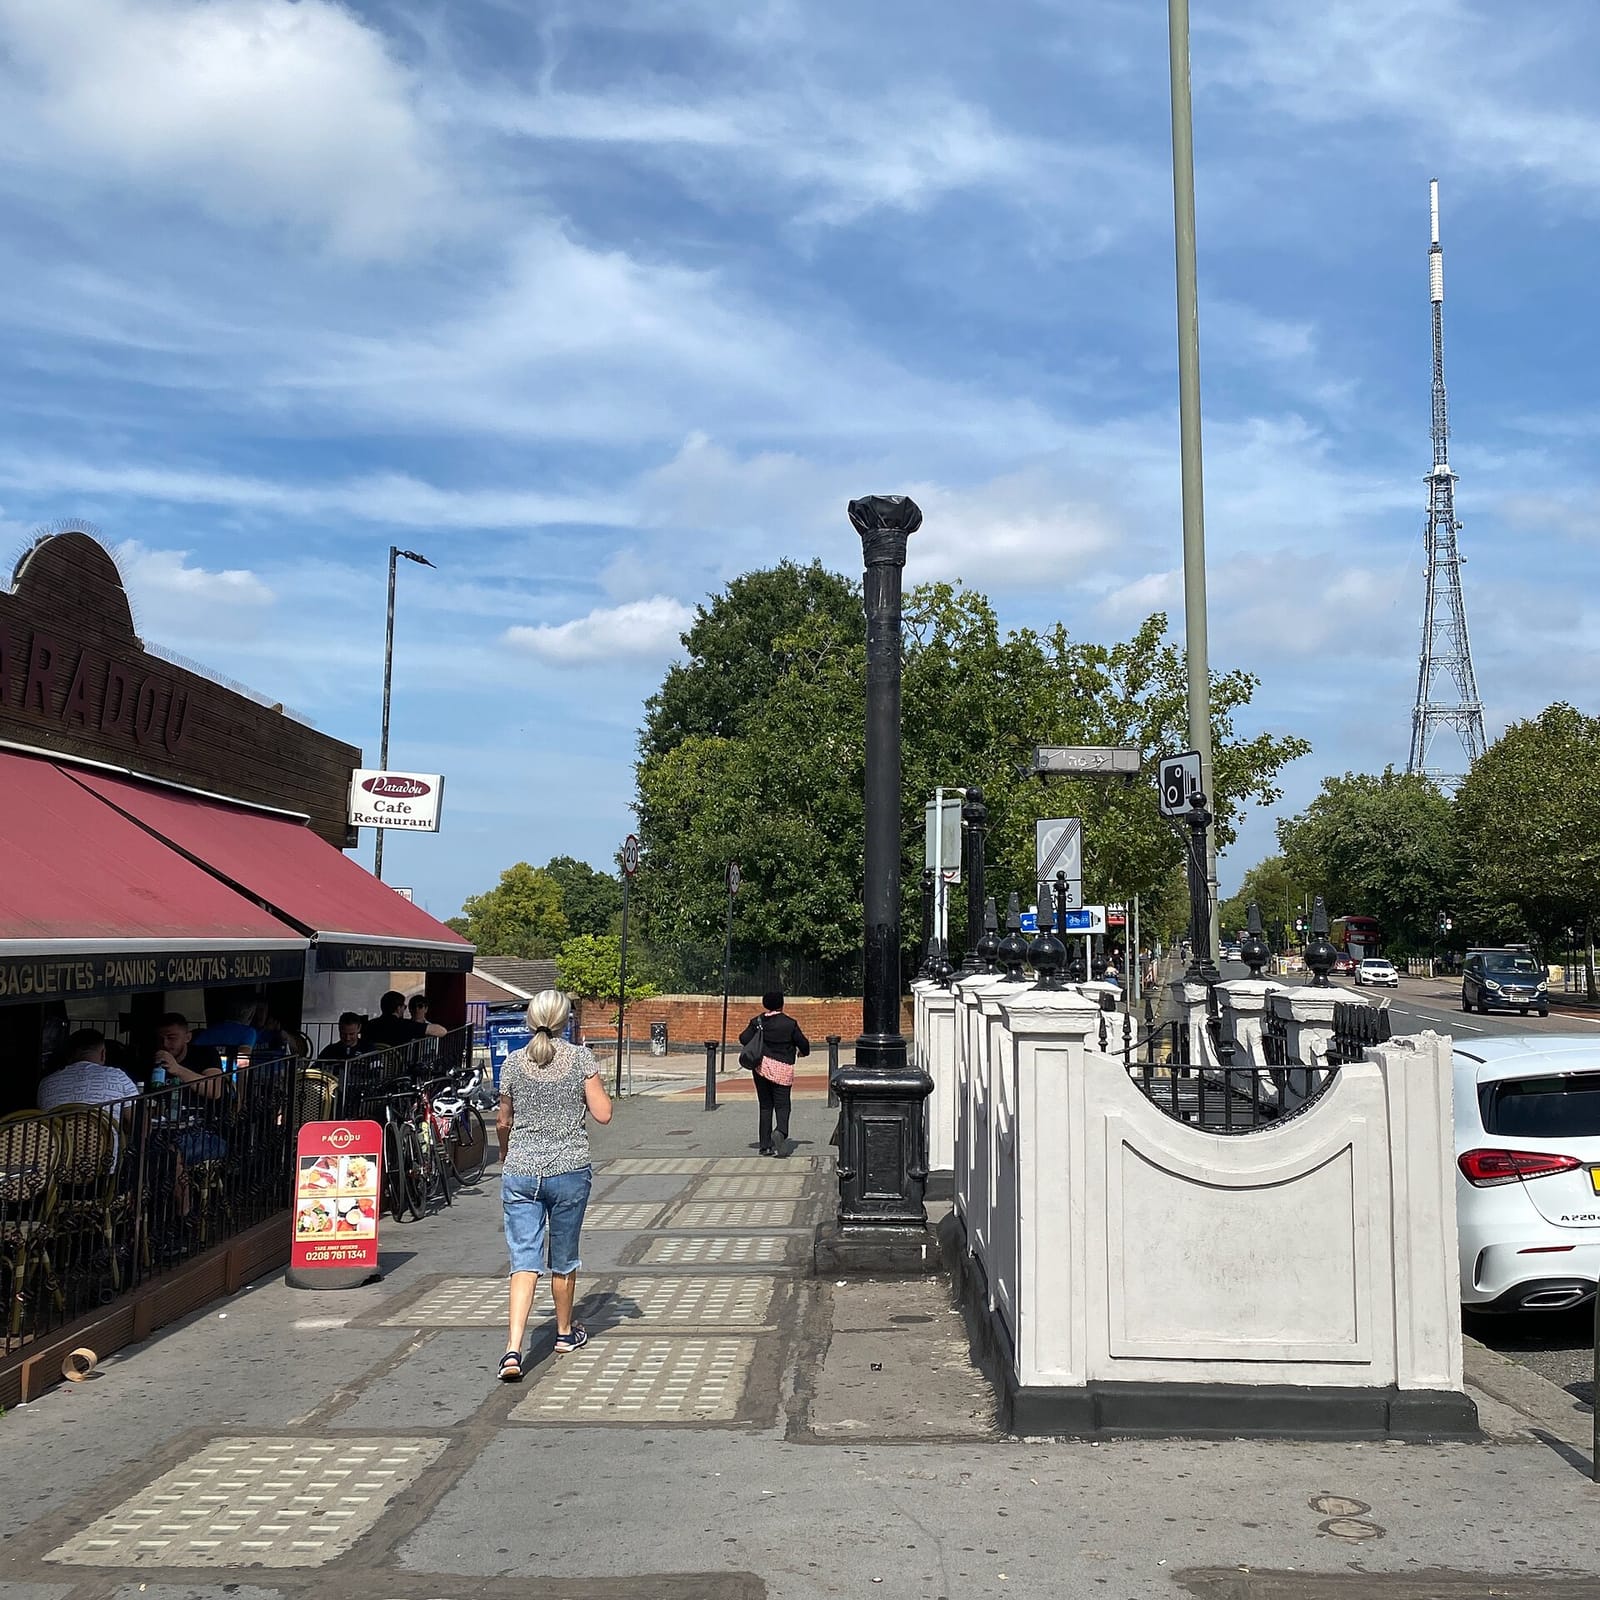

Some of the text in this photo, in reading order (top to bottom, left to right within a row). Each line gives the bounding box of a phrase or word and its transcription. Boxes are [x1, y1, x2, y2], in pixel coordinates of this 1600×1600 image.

[371, 776, 423, 794] Paradou
[373, 800, 412, 814] Cafe
[353, 812, 433, 828] Restaurant
[626, 846, 636, 863] 20
[0, 961, 95, 996] BAGUETTES
[234, 955, 271, 978] SALADS
[305, 1251, 330, 1261] 0208
[347, 1249, 367, 1259] 1341
